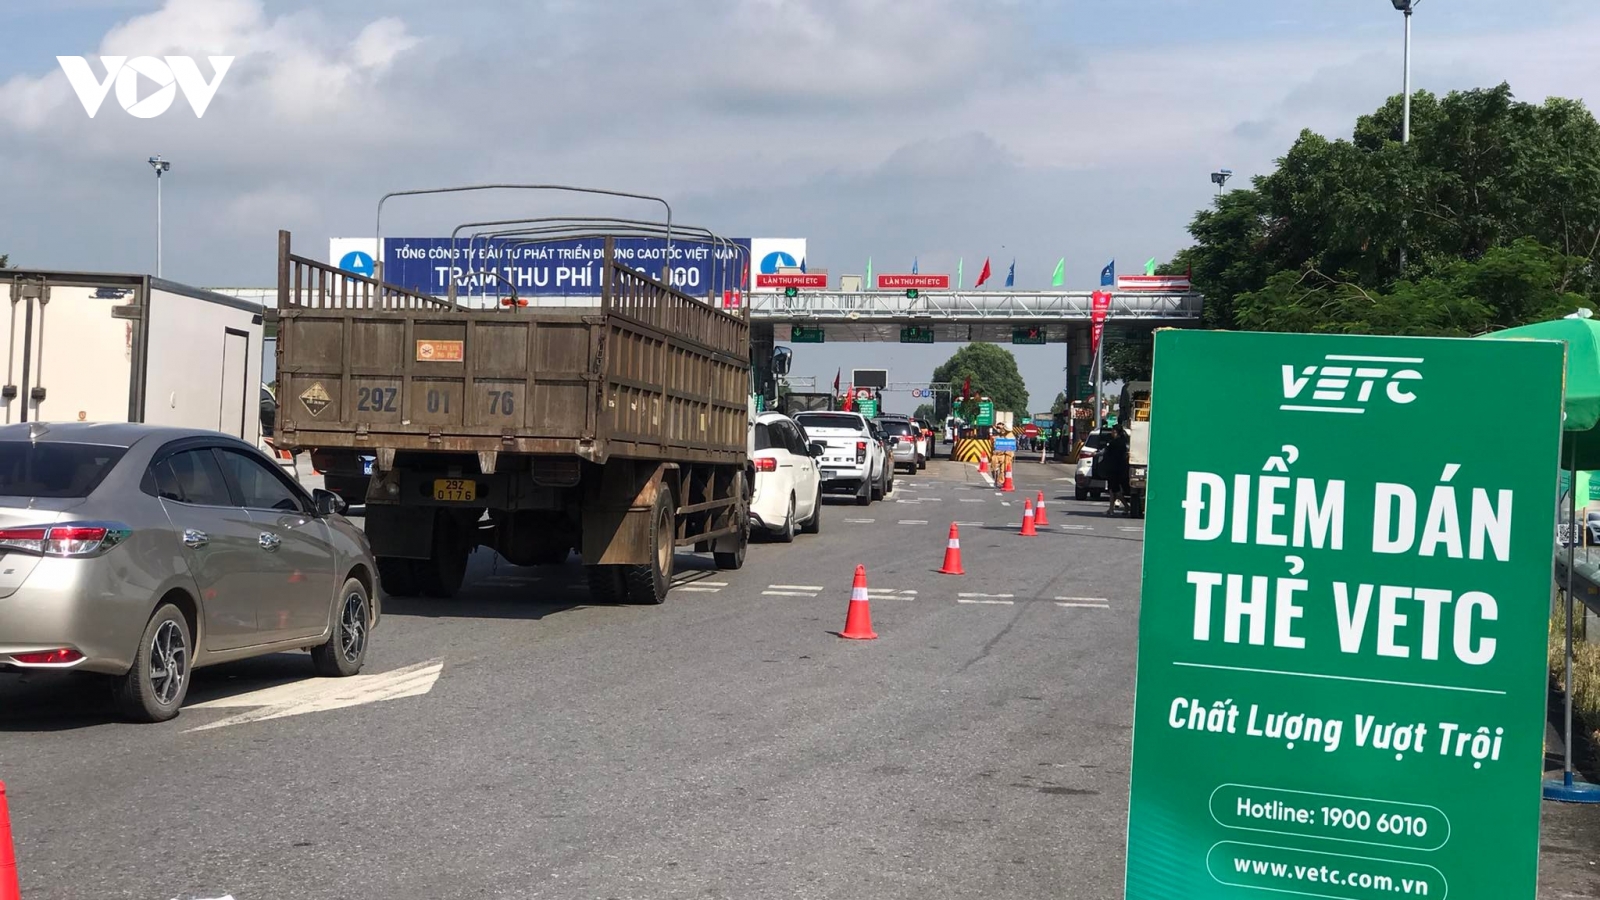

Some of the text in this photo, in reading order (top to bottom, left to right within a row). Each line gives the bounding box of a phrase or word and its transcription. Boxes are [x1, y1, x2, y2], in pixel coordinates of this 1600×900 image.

[395, 244, 426, 259] TỔNG
[429, 245, 460, 259] CÔNG
[462, 248, 476, 259] TY
[479, 245, 503, 259] ĐẦU
[505, 247, 521, 259] TƯ
[524, 245, 554, 259] PHÁT
[557, 244, 591, 259] TRIỂN
[637, 248, 659, 259] CAO
[660, 245, 682, 259] TỐC
[686, 246, 709, 261] VIỆT
[435, 267, 497, 291] TRẠM
[504, 267, 549, 287] THU
[556, 261, 593, 287] PHÍ
[763, 276, 778, 284] LÀN
[793, 276, 805, 284] PHÍ
[885, 277, 900, 285] LÀN
[915, 277, 927, 285] PHÍ
[1282, 364, 1423, 404] VETC
[358, 387, 514, 415] 29Z 01 76
[438, 490, 471, 500] 0176
[446, 480, 464, 490] 29Z
[1182, 445, 1513, 562] ĐIỂM DÁN
[1186, 555, 1498, 665] THẺ VETC
[1169, 697, 1504, 769] Chất Lượng Vượt Trội
[1237, 797, 1427, 837] Hotline: 1900 6010
[1234, 857, 1428, 895] www.vetc.com.vn
